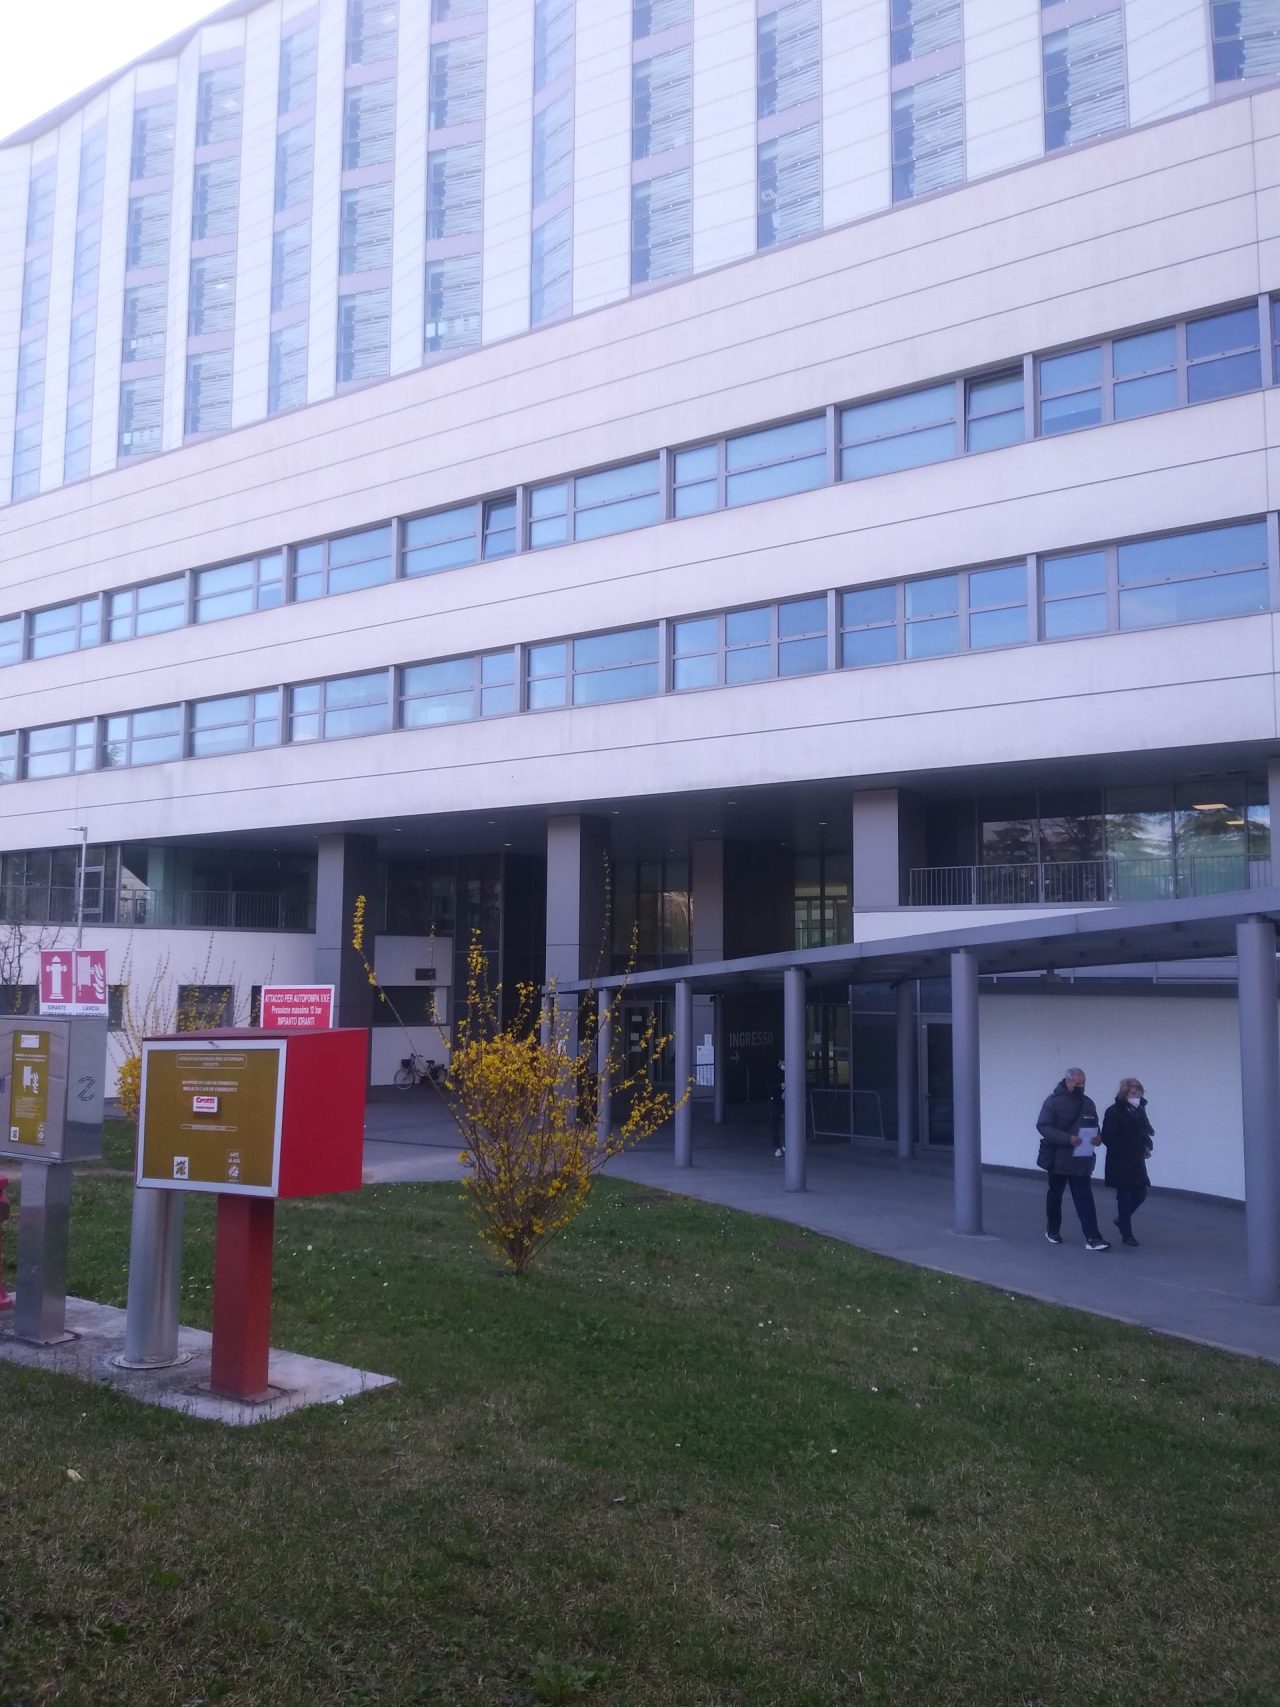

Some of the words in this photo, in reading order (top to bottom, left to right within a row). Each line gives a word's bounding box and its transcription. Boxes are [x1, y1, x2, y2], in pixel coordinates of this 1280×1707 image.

[265, 994, 284, 1002] ATTACCO
[285, 994, 294, 1003] PER
[294, 994, 320, 1003] AUTOPOMPA
[272, 1006, 291, 1014] Pressione
[291, 1005, 310, 1014] massima
[277, 1016, 298, 1026] IMPIANTO
[298, 1017, 314, 1025] IDRANTI
[729, 1030, 774, 1048] INGRESSO
